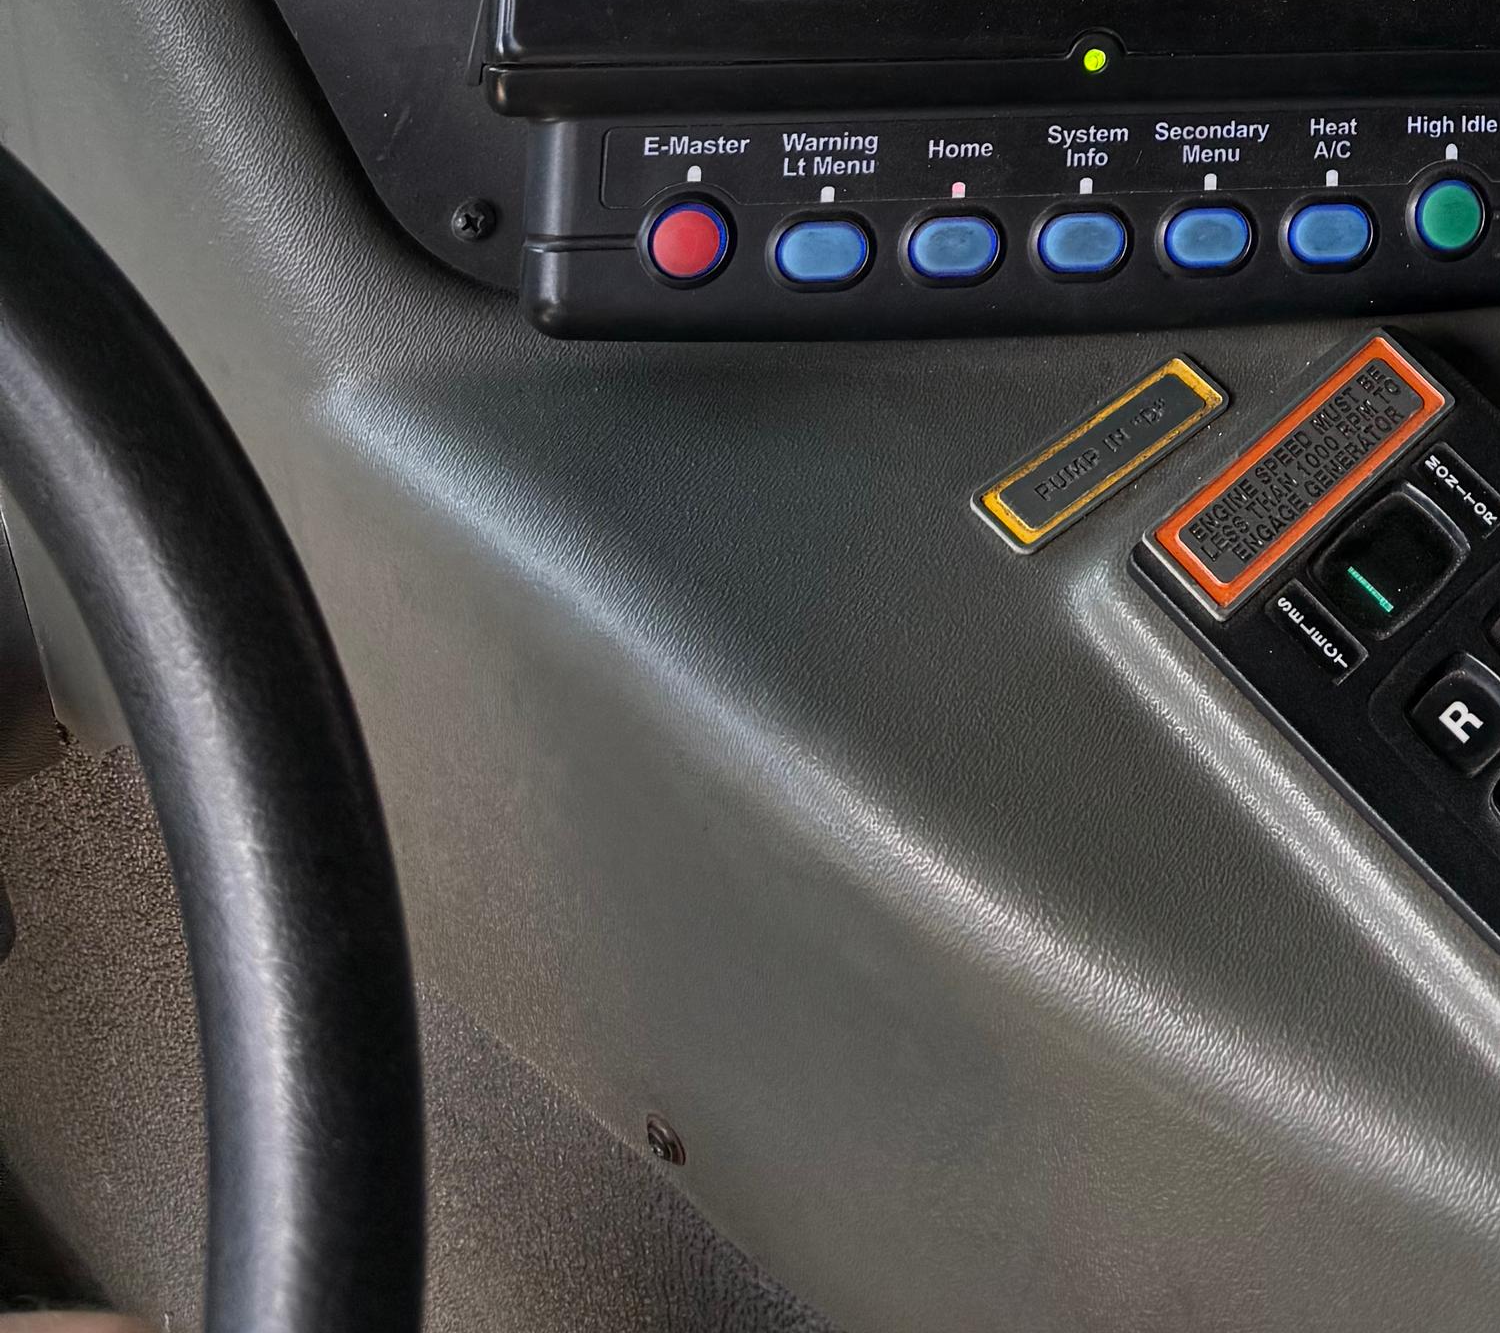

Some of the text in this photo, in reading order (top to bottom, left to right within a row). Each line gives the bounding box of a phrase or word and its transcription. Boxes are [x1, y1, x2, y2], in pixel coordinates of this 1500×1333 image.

[1047, 124, 1130, 147] System
[1154, 121, 1270, 143] Secondary
[1309, 117, 1358, 137] Heat
[1406, 115, 1498, 139] High Idle
[643, 135, 751, 157] E-Master
[782, 131, 879, 153] Warning
[928, 139, 994, 159] Home
[1313, 139, 1351, 160] A/C
[1065, 149, 1109, 168] Info
[1182, 144, 1241, 164] Menu
[783, 155, 876, 177] Lt Menu
[1034, 447, 1100, 502] PUMP
[1102, 427, 1132, 453] IN
[1188, 364, 1384, 543] ENGINE SPEED MUST BE
[1201, 376, 1402, 562] LESS THAN 1000 RPM TO
[1231, 404, 1405, 564] ENGAGE GENERATOR
[1424, 454, 1498, 526] MONITOR
[1277, 596, 1349, 669] SELECT
[1438, 700, 1484, 744] R
